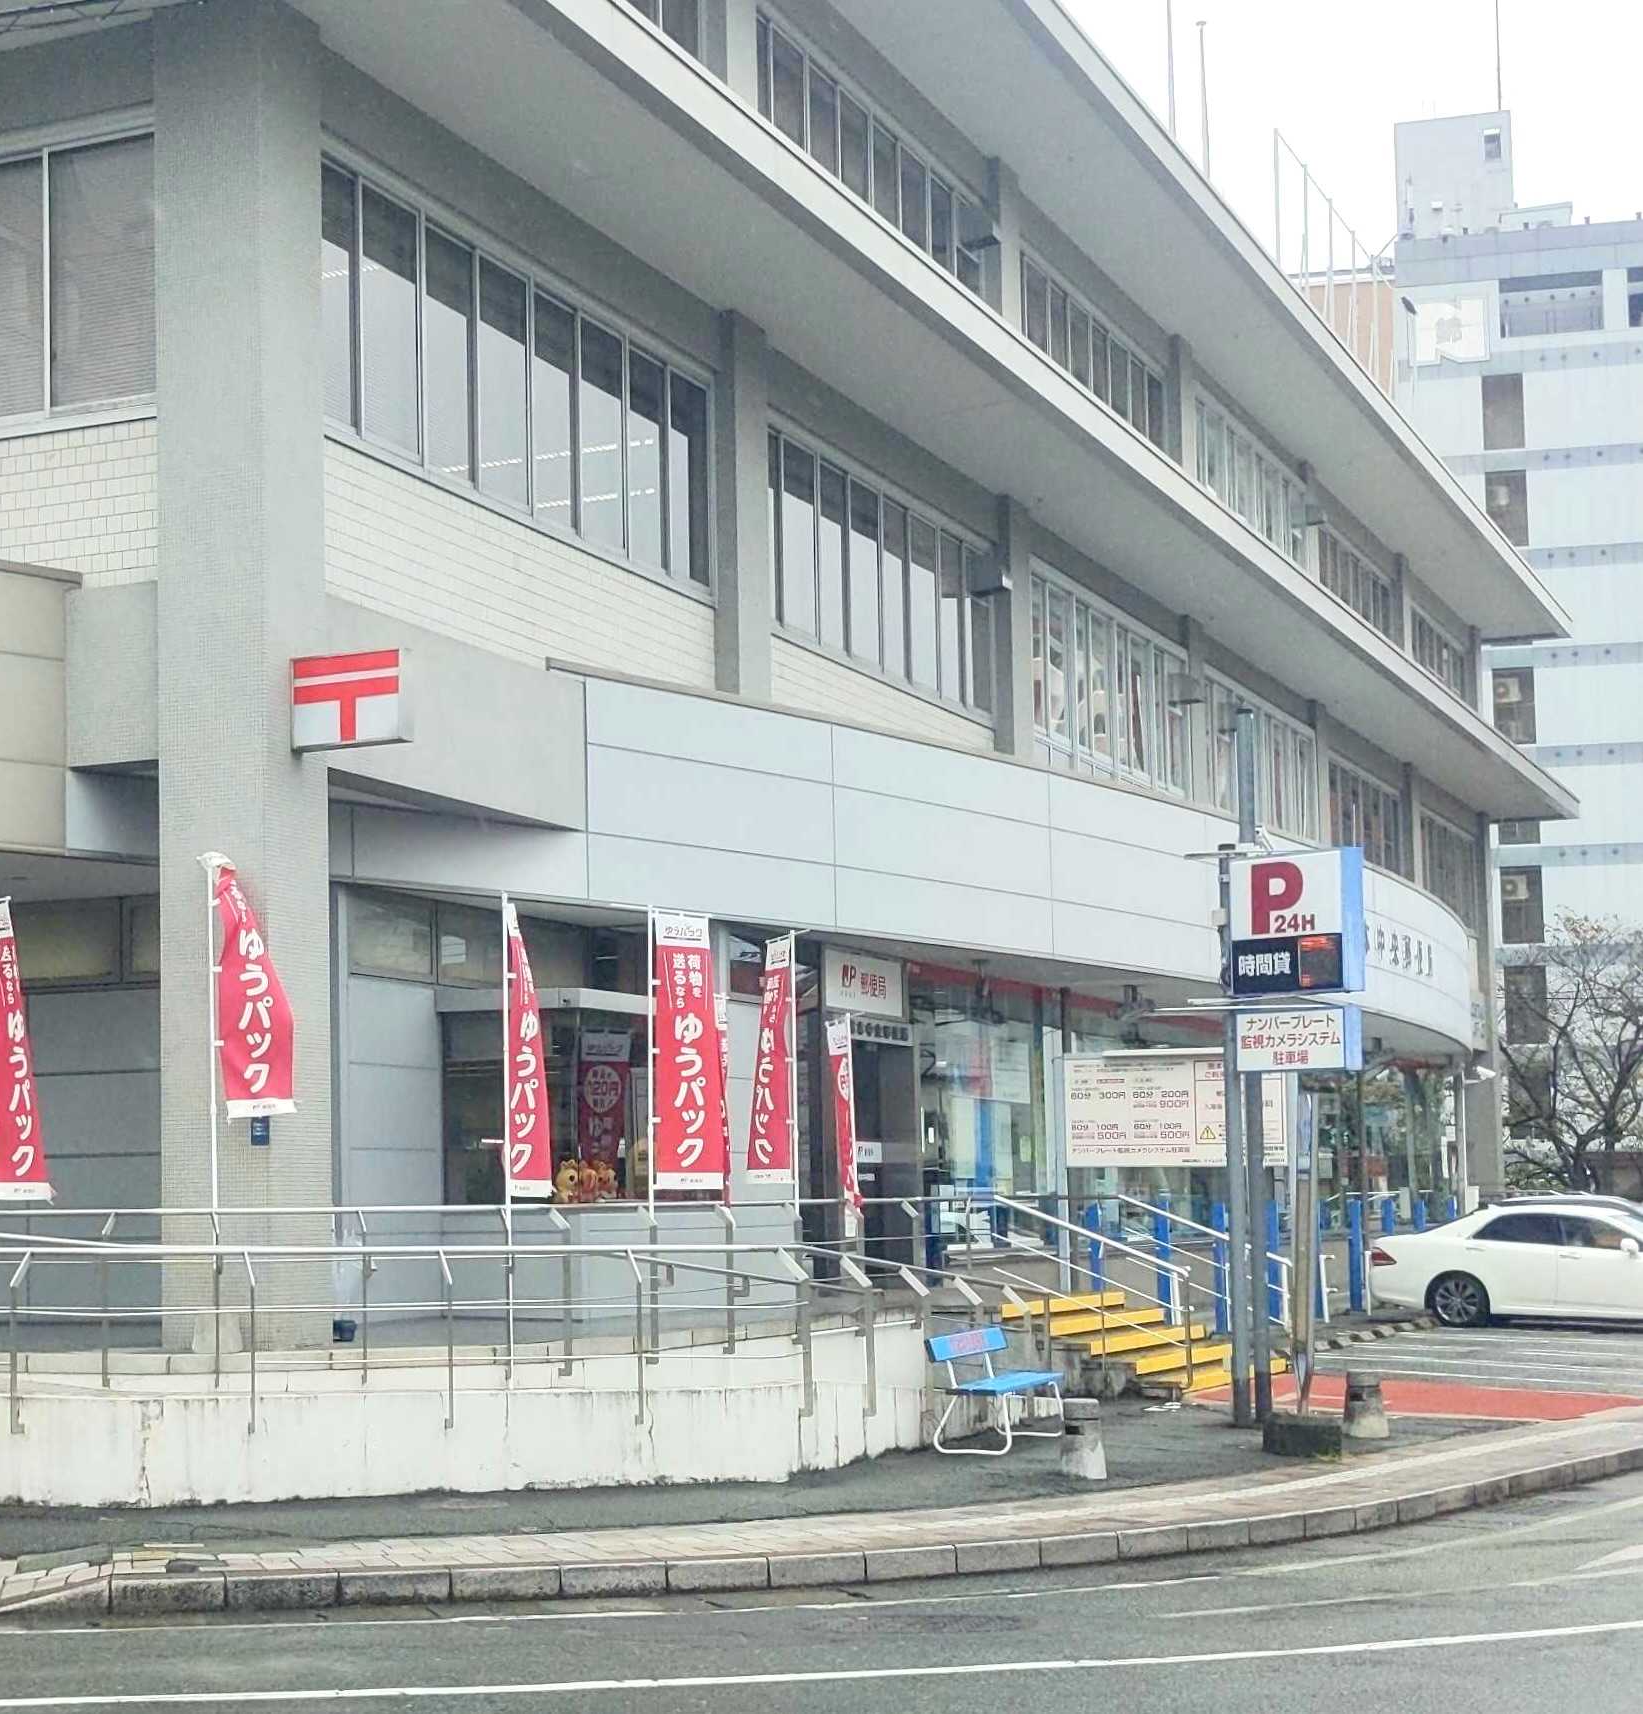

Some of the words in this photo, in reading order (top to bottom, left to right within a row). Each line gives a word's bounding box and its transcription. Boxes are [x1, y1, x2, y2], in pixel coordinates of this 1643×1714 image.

[1251, 861, 1304, 935] P
[1274, 913, 1316, 934] 24H
[672, 953, 686, 1009] 送るなら
[687, 954, 703, 998] 荷物を
[1238, 951, 1291, 977] 時間貸
[238, 928, 274, 1094] ゆうパック
[1246, 1013, 1335, 1030] ナンバープレート
[1241, 1032, 1341, 1050] 監視カメラシステム
[1272, 1050, 1309, 1066] 駐車場
[7, 1011, 35, 1177] ゆうパック
[510, 1010, 540, 1175] ゆうパック
[674, 1012, 706, 1168] ゆうパック
